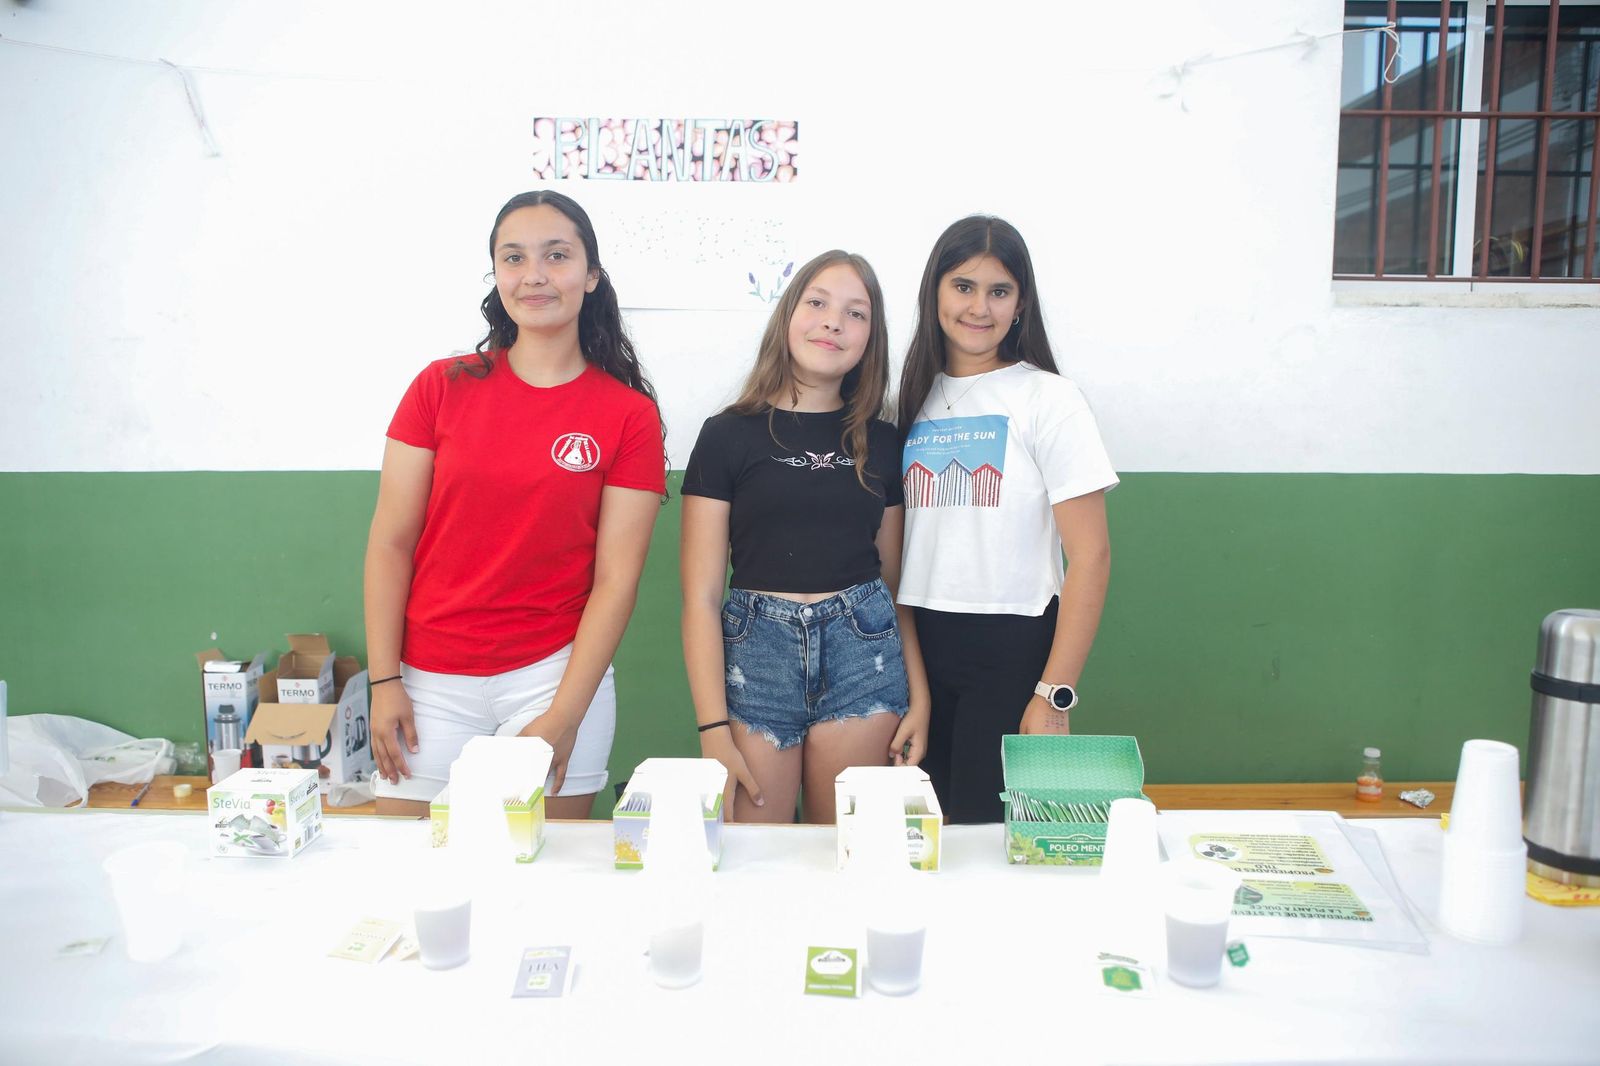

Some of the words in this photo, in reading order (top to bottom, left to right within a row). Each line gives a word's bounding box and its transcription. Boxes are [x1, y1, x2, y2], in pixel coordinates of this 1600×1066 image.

[554, 116, 780, 183] PLANTAS
[905, 436, 930, 447] EADY
[932, 434, 952, 444] FOR
[953, 432, 970, 441] THE
[972, 431, 996, 440] SUN
[208, 682, 242, 691] TERMO
[281, 689, 315, 697] TERMO
[1049, 843, 1079, 852] POLEO
[1080, 844, 1105, 853] MENT
